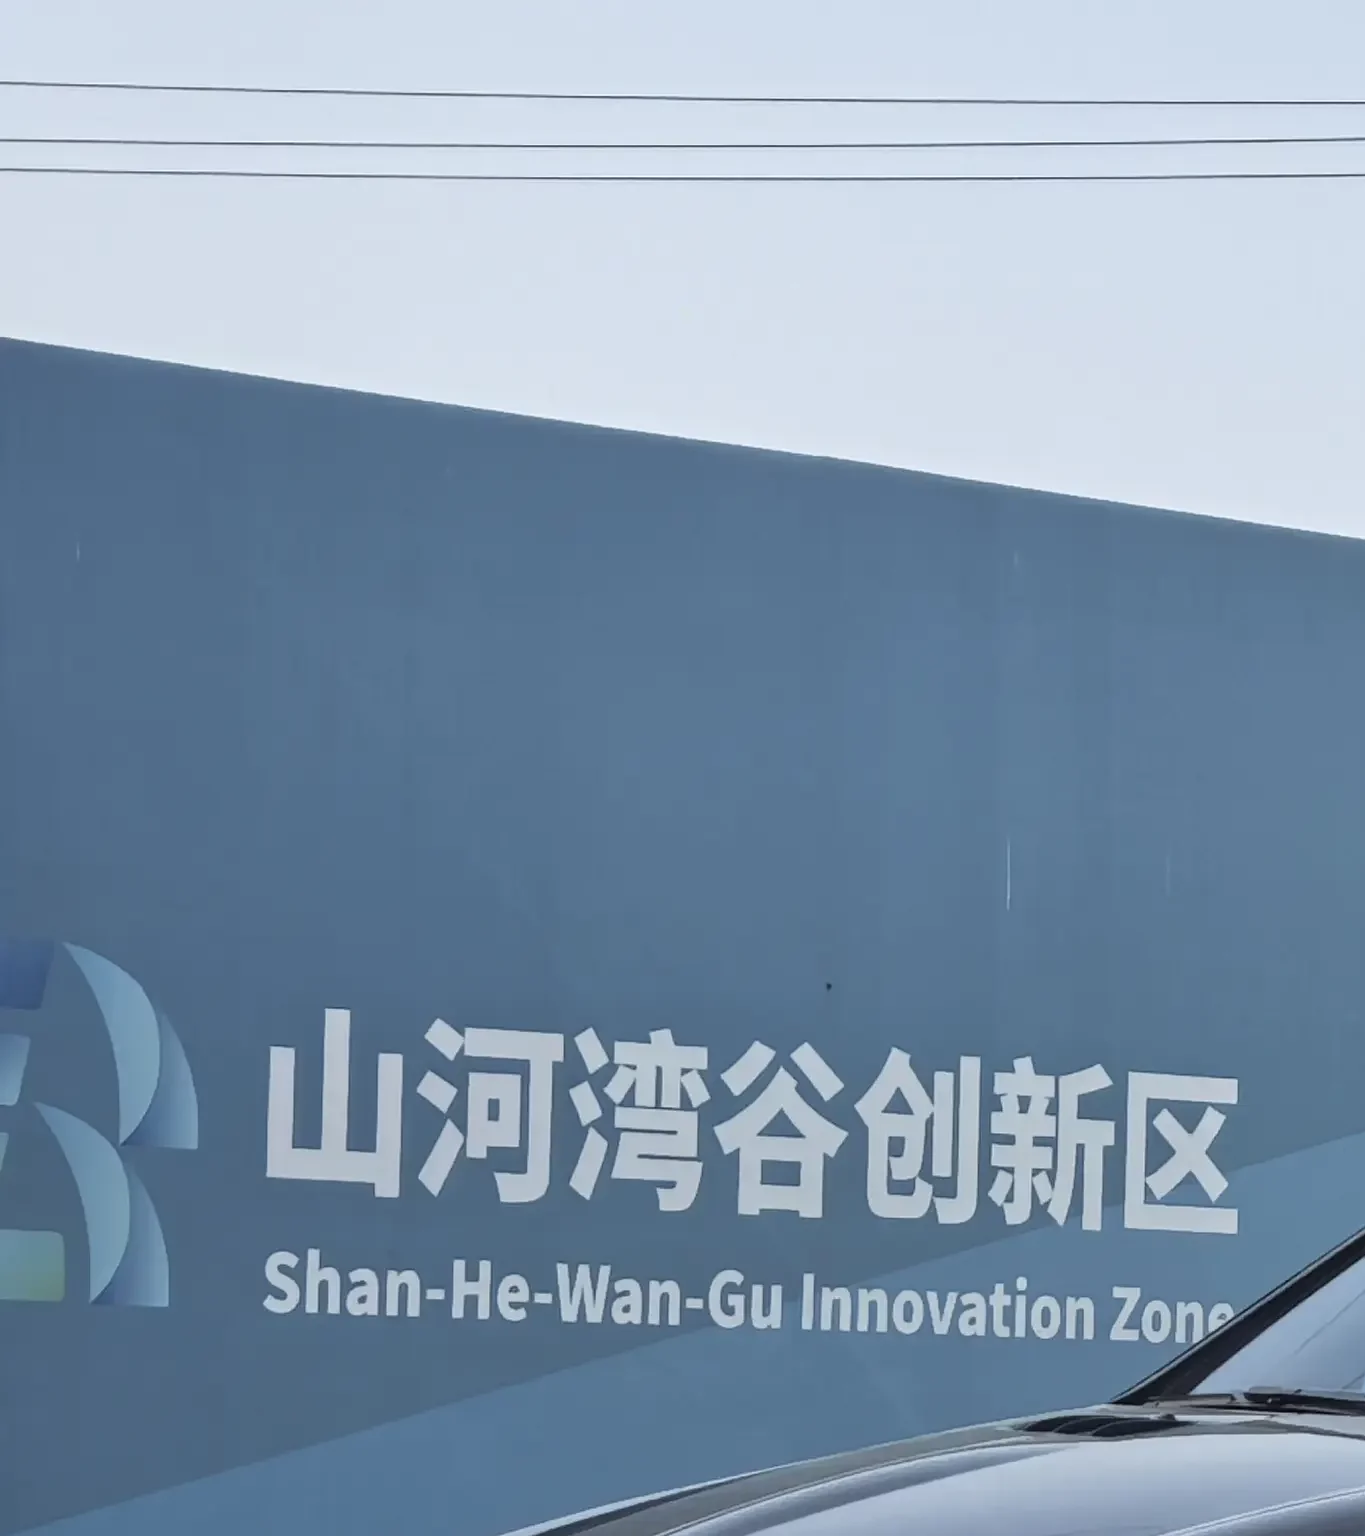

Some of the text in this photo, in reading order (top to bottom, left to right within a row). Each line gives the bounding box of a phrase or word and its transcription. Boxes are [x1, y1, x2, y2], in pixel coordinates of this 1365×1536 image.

[265, 1007, 1240, 1236] 山河湾谷创新区
[262, 1249, 782, 1330] Shan-He-Wan-Gu
[800, 1272, 1095, 1341] Innovation
